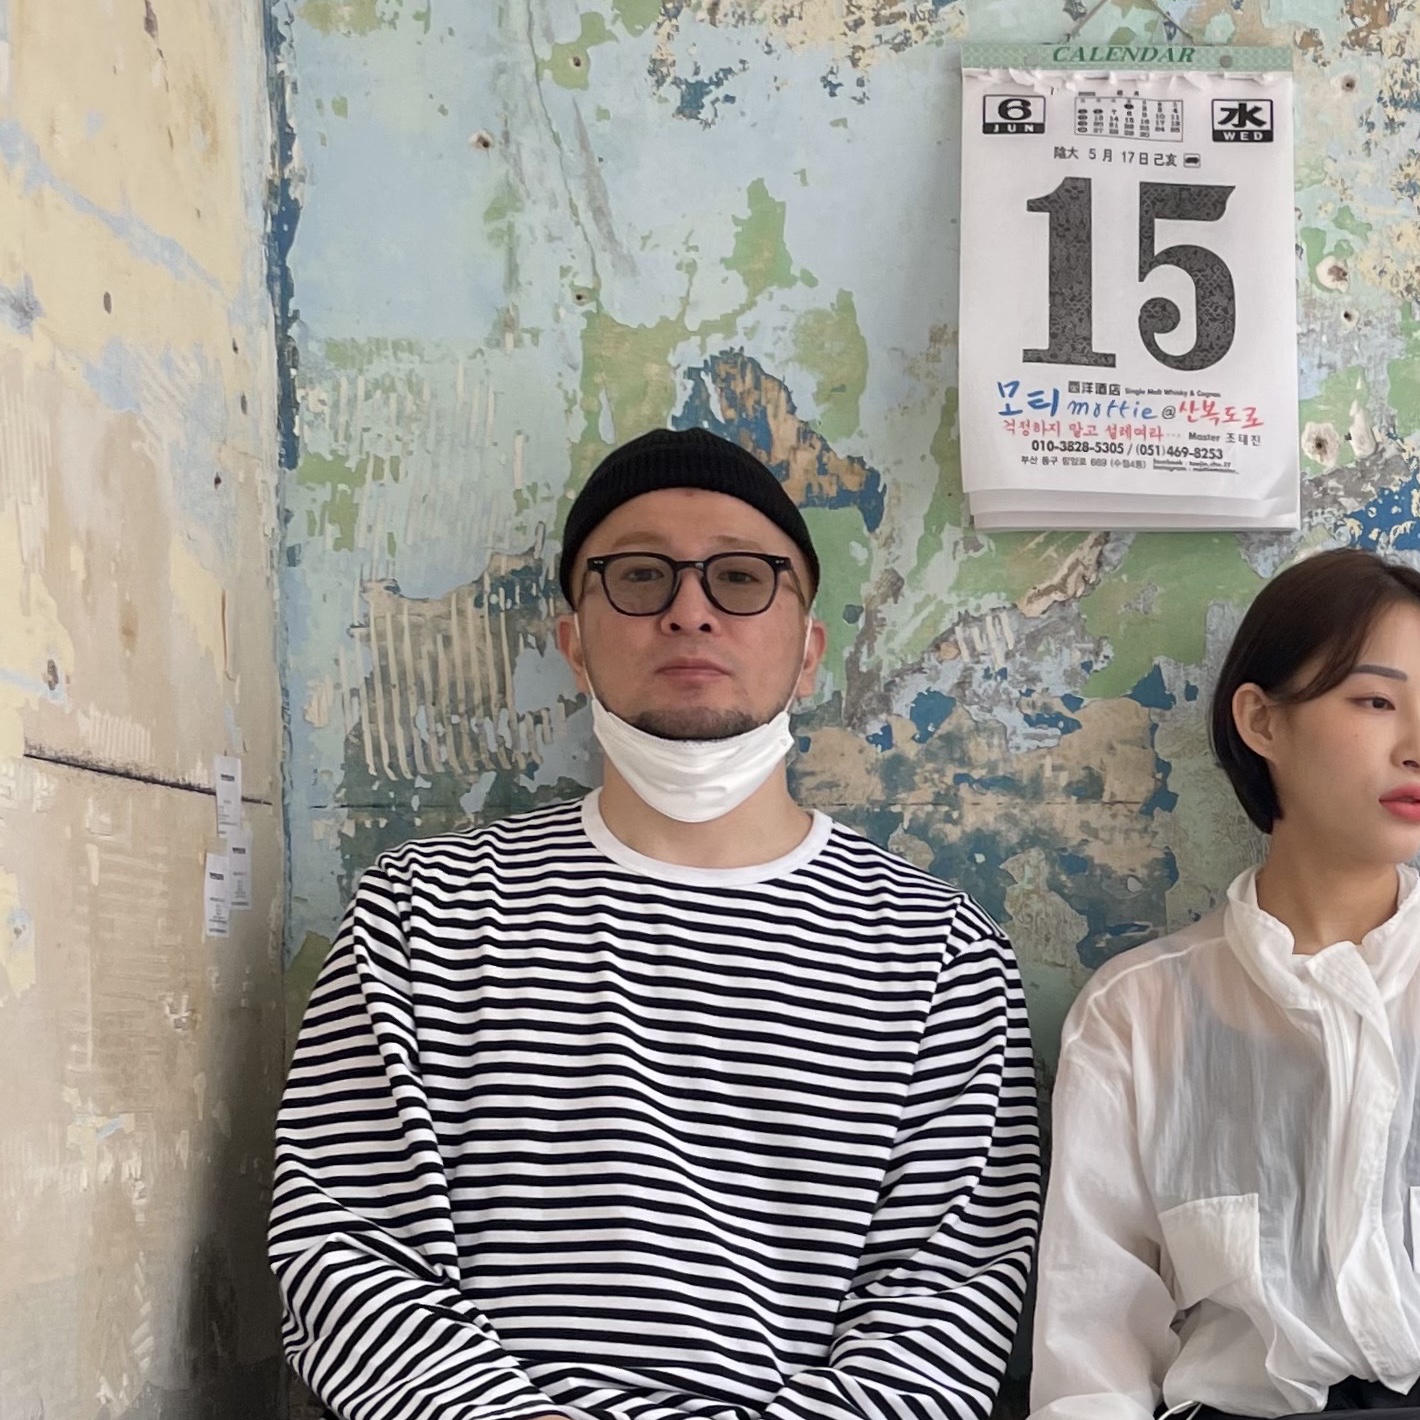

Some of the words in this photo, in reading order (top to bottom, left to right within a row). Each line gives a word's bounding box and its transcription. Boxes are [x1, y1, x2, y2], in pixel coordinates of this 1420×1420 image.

[1053, 46, 1196, 63] CALENDAR
[998, 98, 1032, 121] 6
[1217, 102, 1267, 128] 水
[993, 124, 1034, 132] JUN
[1223, 131, 1263, 141] WED
[1102, 149, 1112, 162] 月
[1122, 151, 1134, 163] 17
[1139, 152, 1149, 165] 日
[1022, 176, 1236, 371] 15
[1179, 400, 1264, 429] 산복도로
[1003, 418, 1060, 437] 걱정하지
[1069, 421, 1099, 439] 말고
[1189, 431, 1220, 442] Master
[1031, 440, 1124, 455] 010-3828-5305
